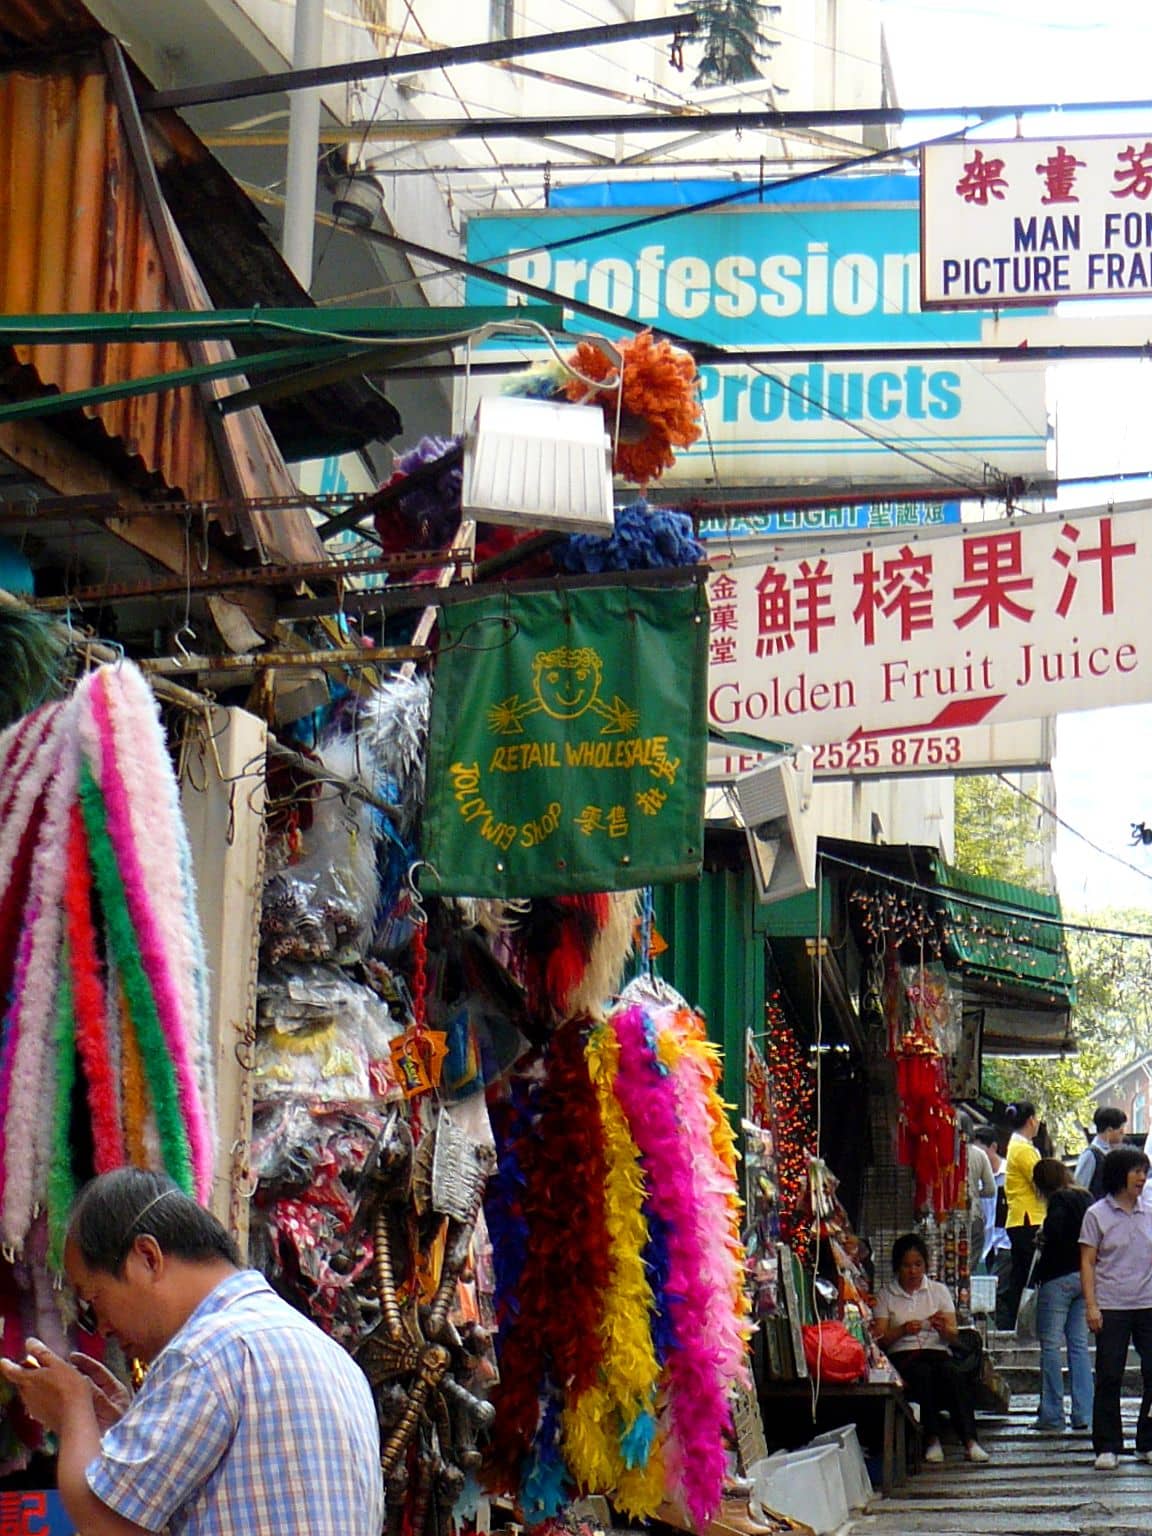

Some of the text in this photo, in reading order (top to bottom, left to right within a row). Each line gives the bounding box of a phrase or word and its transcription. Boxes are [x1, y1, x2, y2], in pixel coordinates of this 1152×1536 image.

[1013, 215, 1081, 251] MAN
[505, 242, 922, 318] Profession
[943, 255, 1071, 295] PICTURE
[694, 364, 962, 423] Products
[776, 503, 863, 529] LIGHT
[755, 518, 1137, 659] 鮮榨果汁
[709, 636, 1138, 726] Golden Fruit Juice
[490, 736, 669, 773] RETAIL WHOLESALE
[812, 740, 879, 769] 2525
[891, 736, 962, 766] 8753
